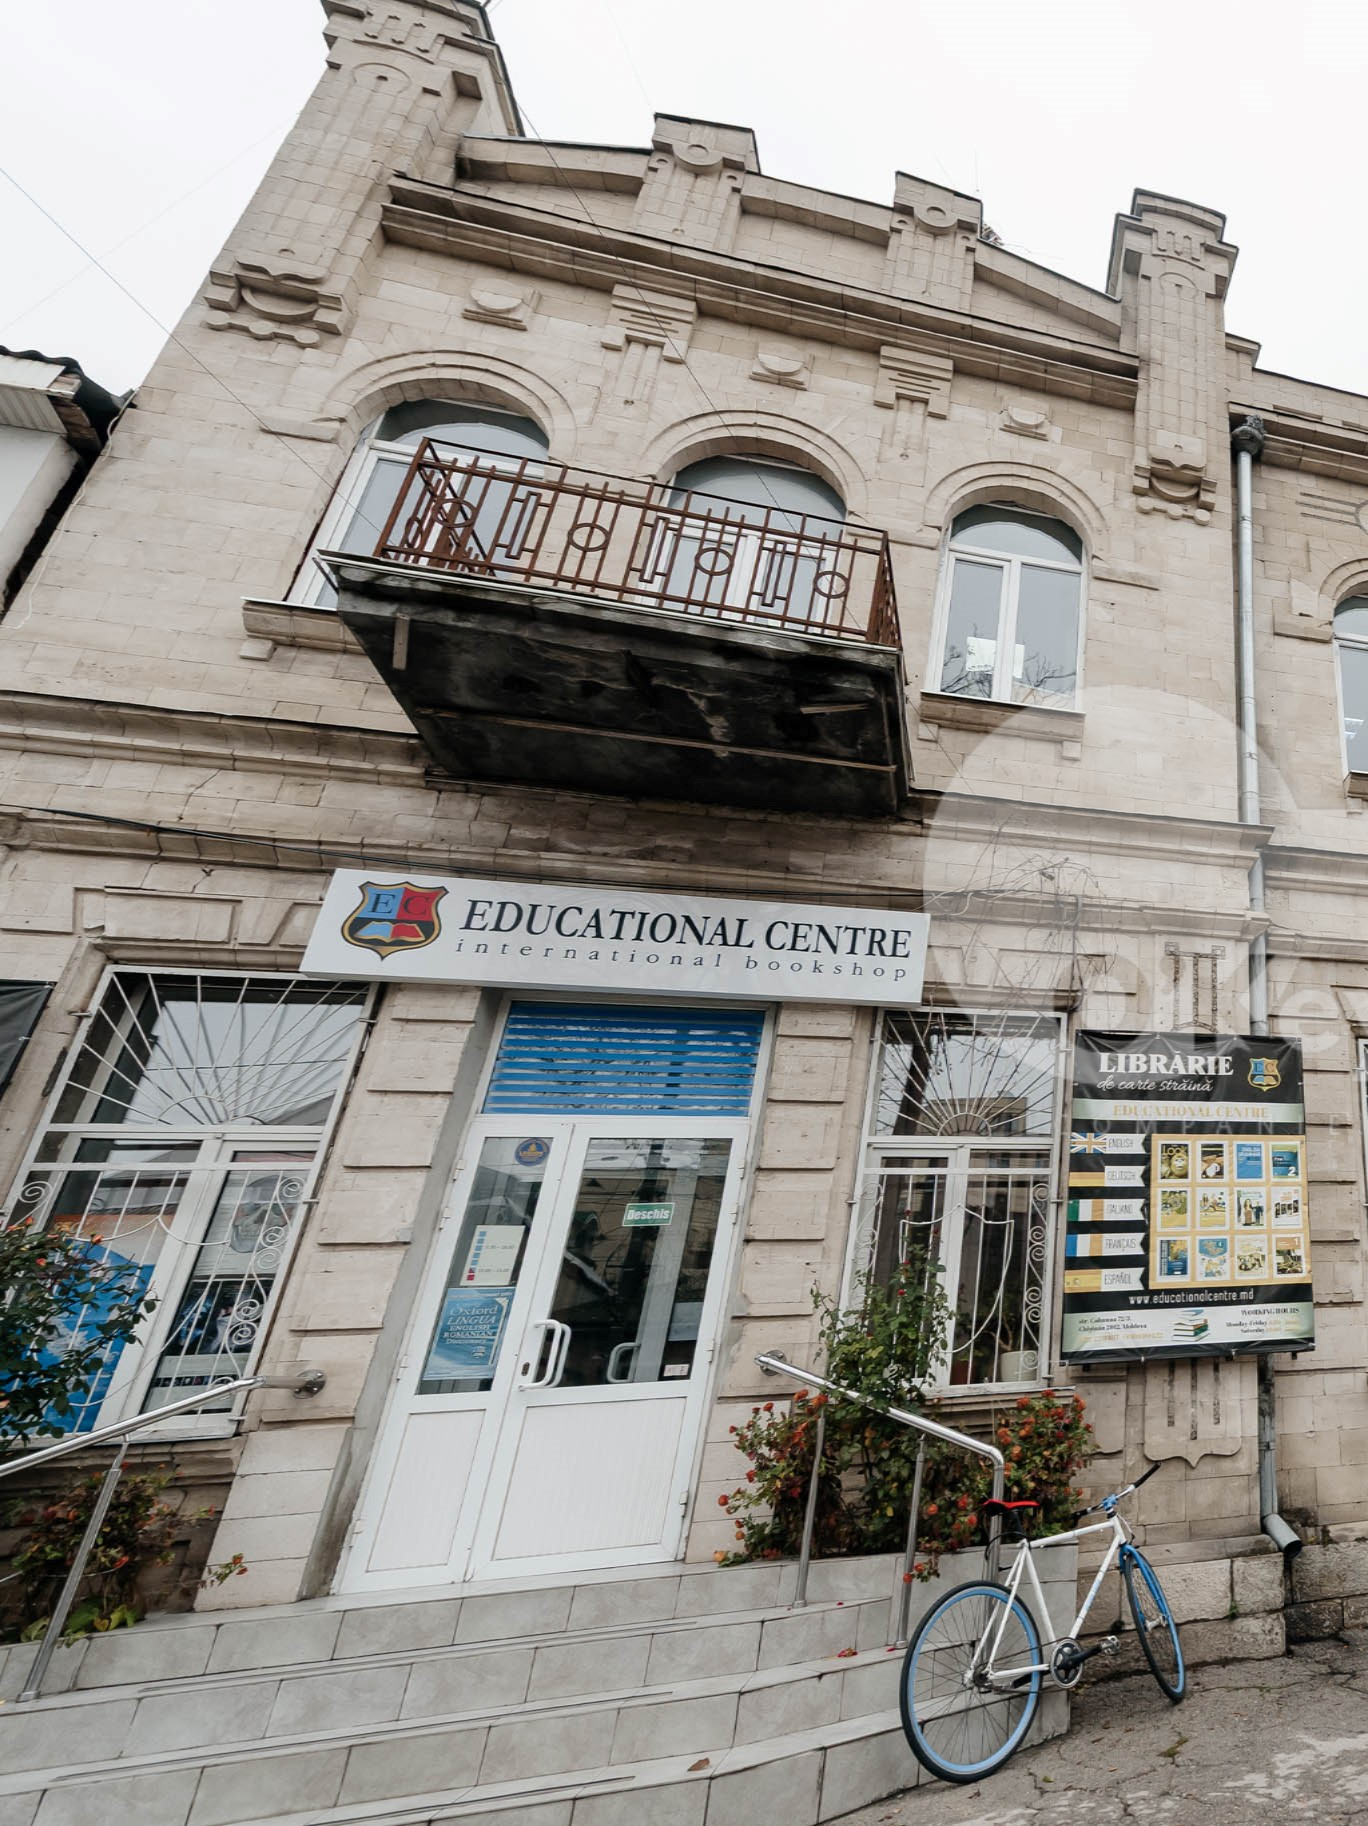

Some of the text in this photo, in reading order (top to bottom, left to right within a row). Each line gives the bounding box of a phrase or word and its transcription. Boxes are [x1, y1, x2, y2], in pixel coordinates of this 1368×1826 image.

[369, 893, 430, 916] EC
[459, 899, 913, 959] EDUCATIONAL CENTRE
[455, 938, 907, 982] international bookshop
[1098, 1051, 1234, 1076] LIBRĂRIE
[1254, 1062, 1275, 1075] EC
[1097, 1075, 1214, 1092] de carte străină
[1113, 1104, 1269, 1118] EDUCATIONAL CENTRE
[626, 1208, 670, 1220] Deschis
[1104, 1271, 1132, 1285] ESPAÑOL
[1128, 1288, 1254, 1305] www.educationalcentre.md
[449, 1305, 498, 1316] Oxford
[447, 1315, 496, 1326] LINGUA
[443, 1331, 494, 1339] ROMANIAN
